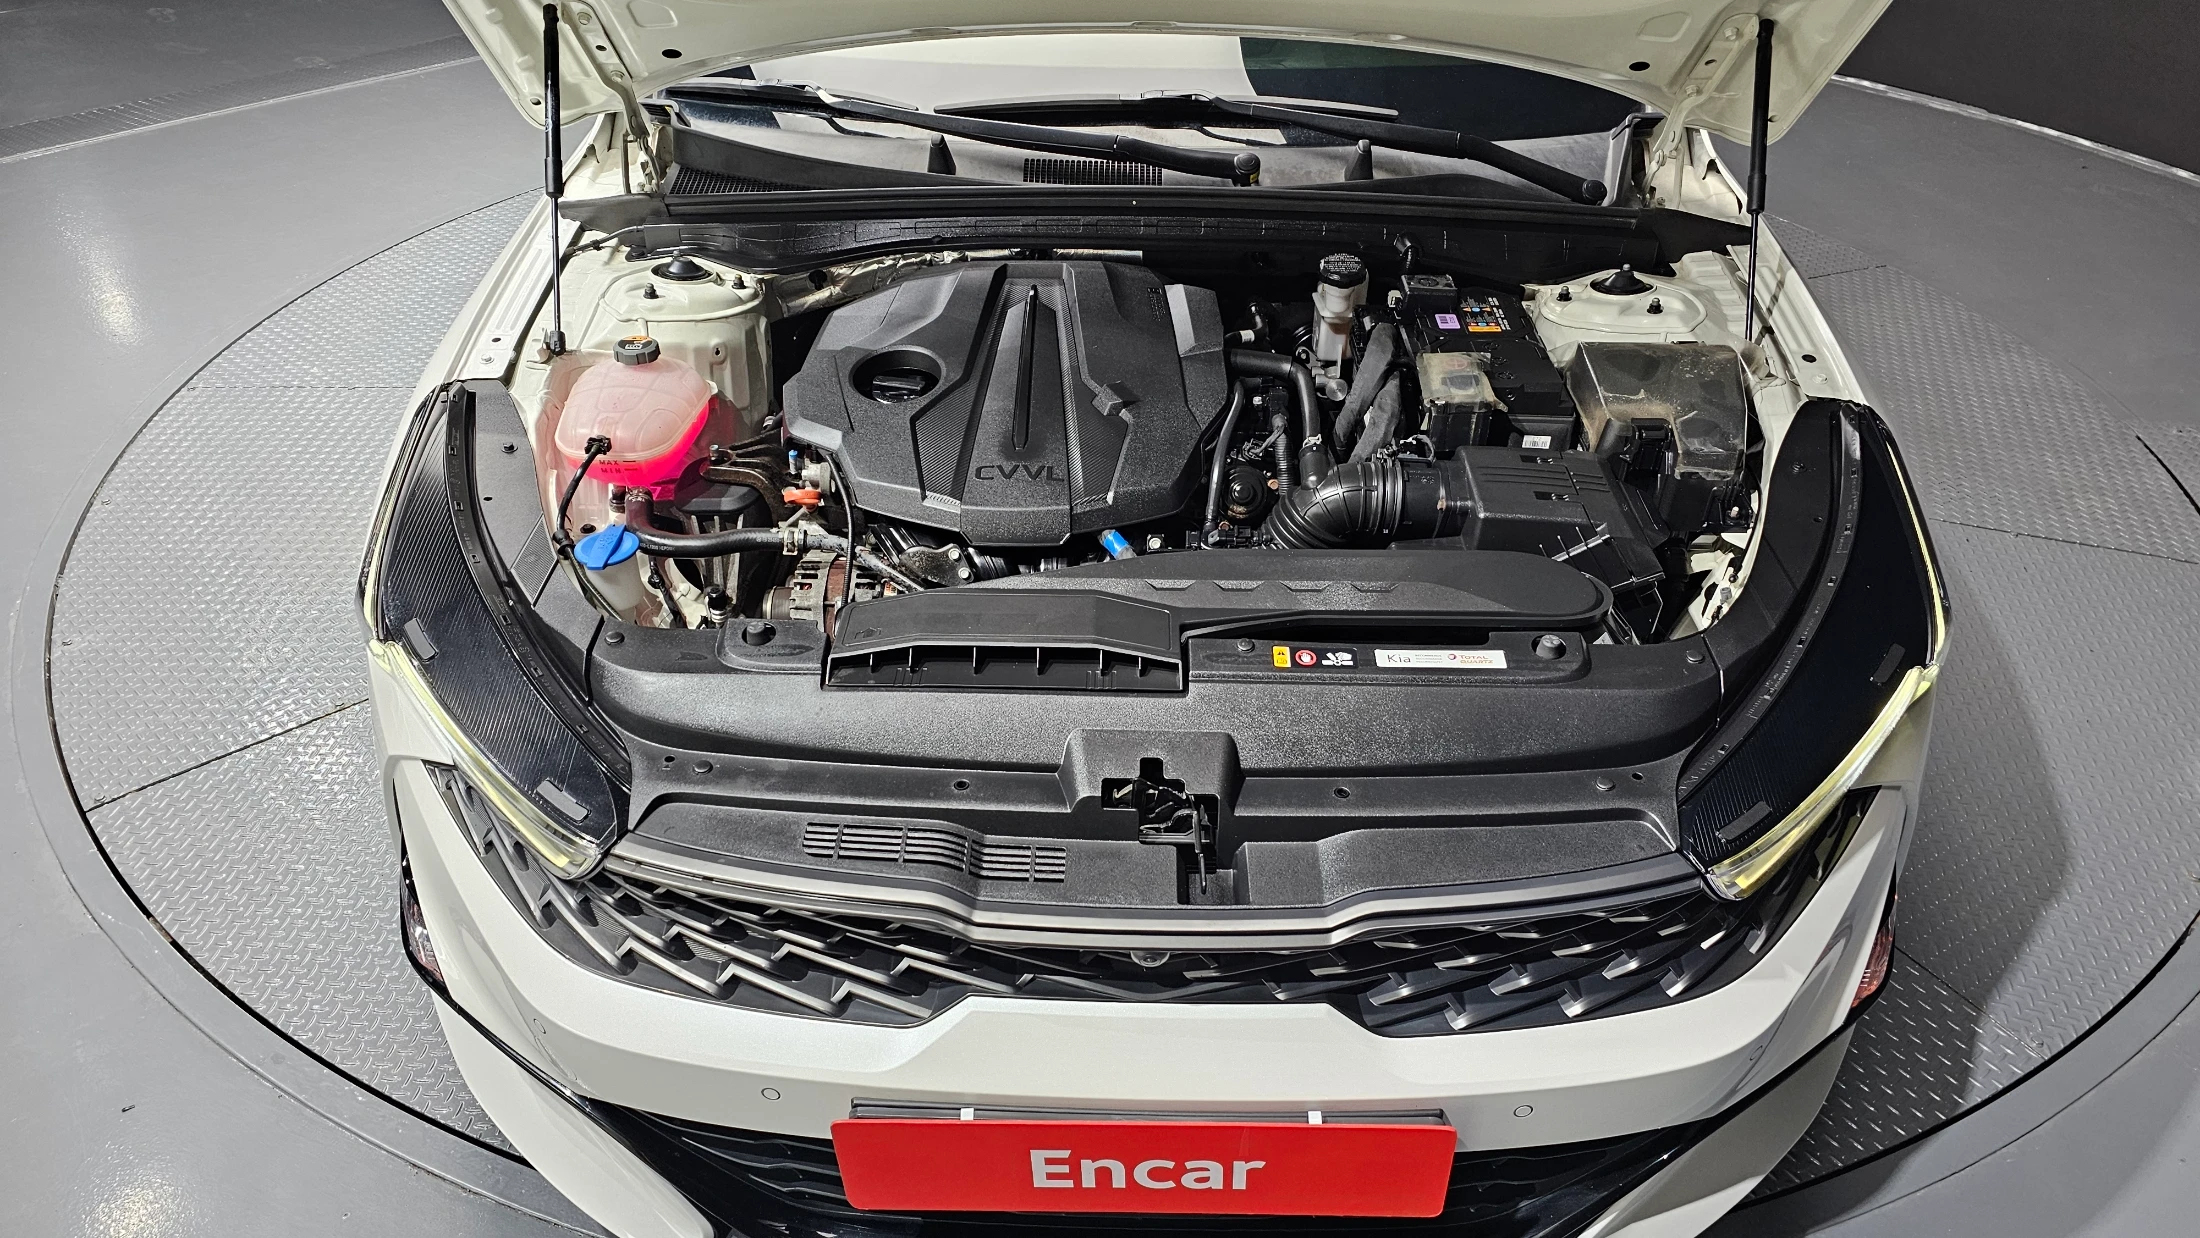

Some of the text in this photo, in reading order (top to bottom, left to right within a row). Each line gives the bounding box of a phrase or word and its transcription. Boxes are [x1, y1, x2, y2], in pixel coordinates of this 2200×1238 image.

[975, 465, 1064, 481] CVVL
[1387, 654, 1411, 663] Kia
[1030, 1150, 1266, 1190] Encar
